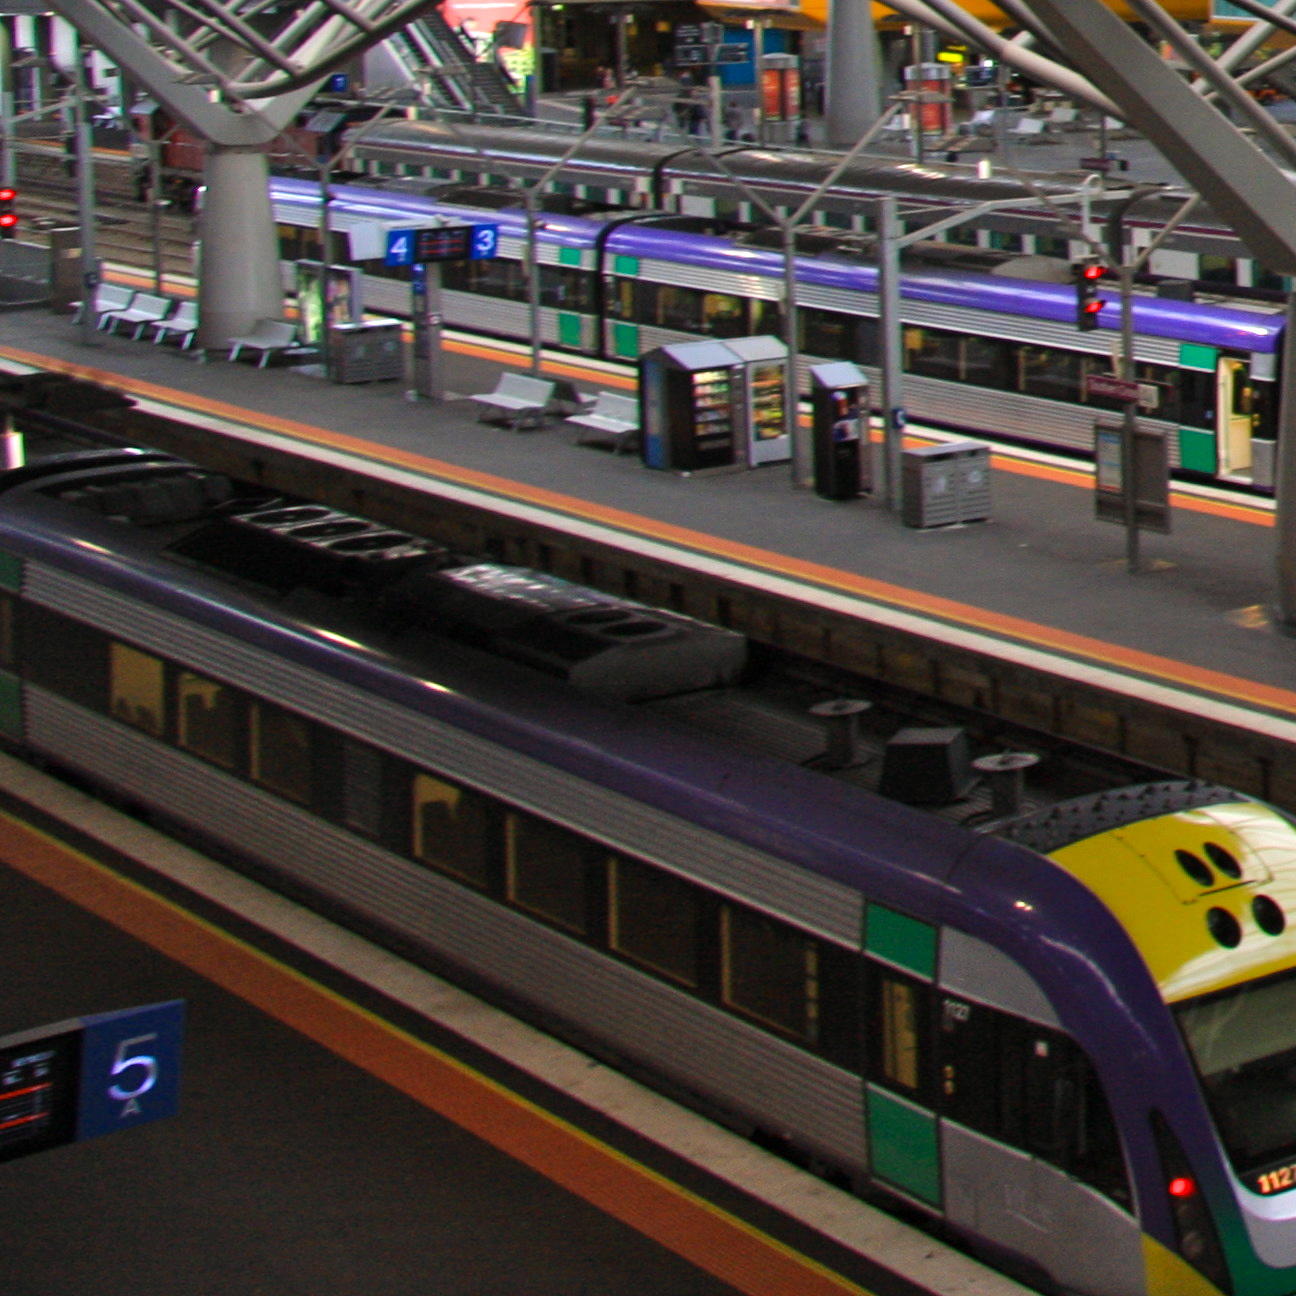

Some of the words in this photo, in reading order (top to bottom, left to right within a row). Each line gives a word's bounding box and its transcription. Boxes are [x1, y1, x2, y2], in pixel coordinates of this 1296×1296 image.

[390, 236, 408, 253] 4
[475, 229, 495, 251] 3
[107, 1032, 158, 1101] 5
